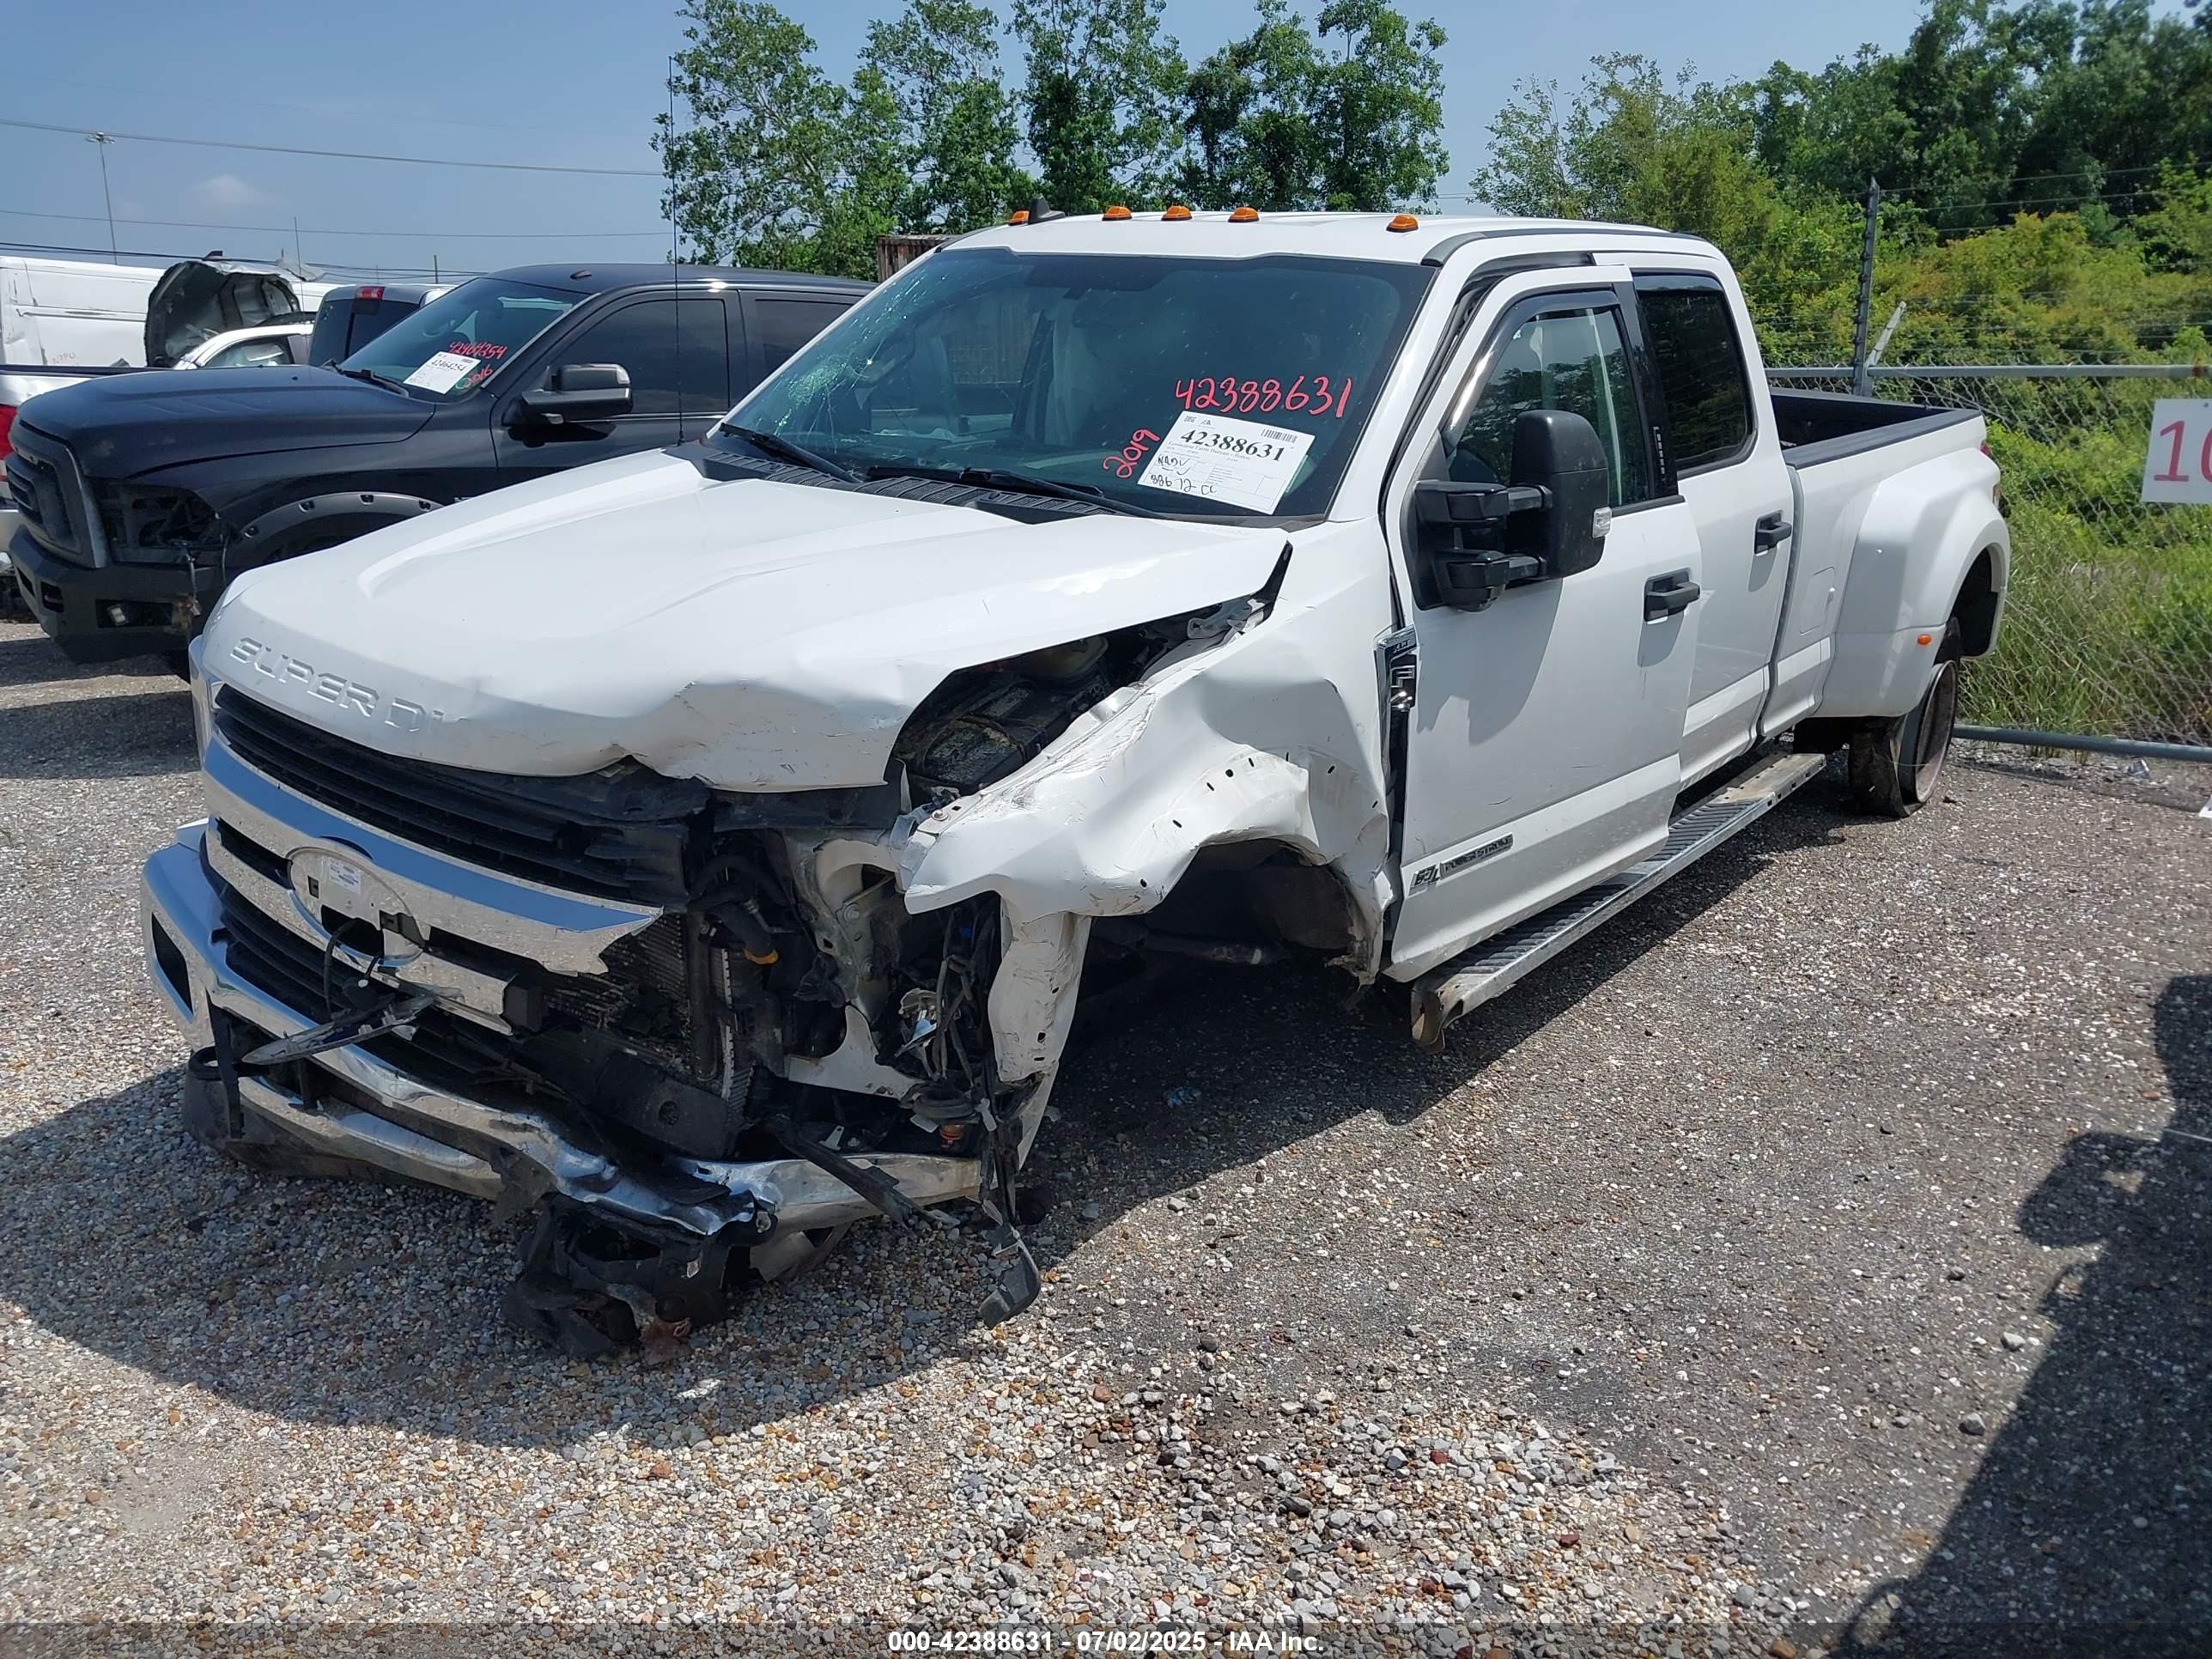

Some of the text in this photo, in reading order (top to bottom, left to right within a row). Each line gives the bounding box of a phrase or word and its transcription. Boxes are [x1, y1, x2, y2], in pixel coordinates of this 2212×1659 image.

[1176, 375, 1352, 418] 42388631
[1103, 428, 1160, 479] 2019
[1180, 428, 1286, 462] 42388631
[230, 636, 380, 717] SUPER
